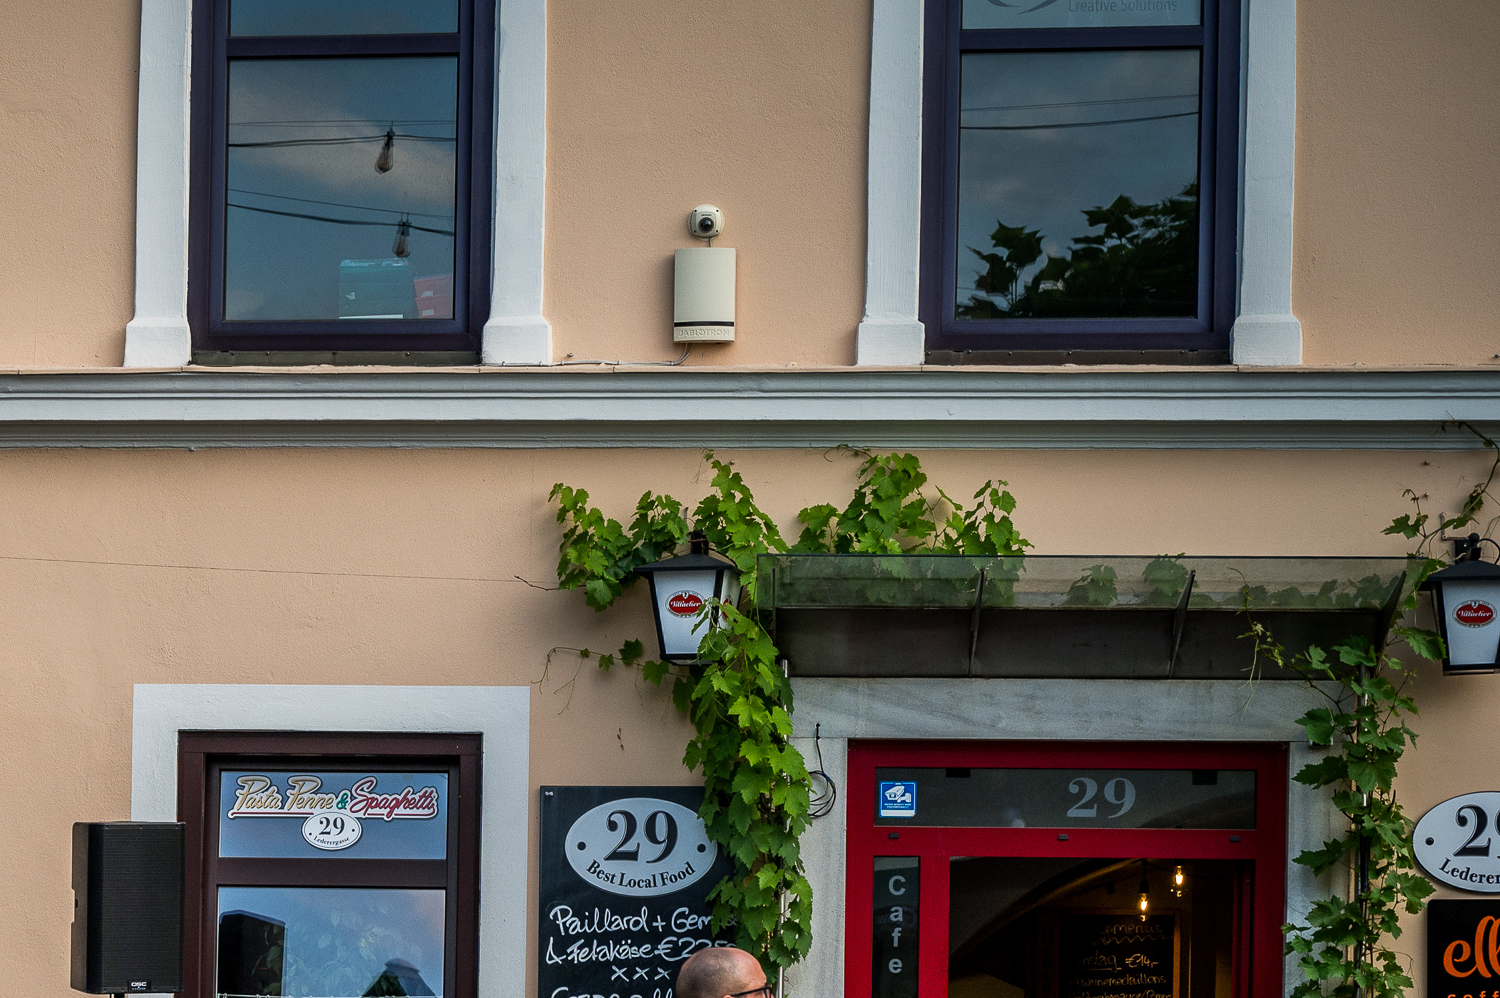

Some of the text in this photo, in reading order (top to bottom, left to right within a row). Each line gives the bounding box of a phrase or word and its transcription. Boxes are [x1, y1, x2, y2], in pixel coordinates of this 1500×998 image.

[236, 778, 436, 819] Pasta Penne & Spaghetti
[1066, 777, 1136, 819] 29
[318, 816, 345, 836] 29
[604, 809, 678, 864] 29
[1453, 804, 1500, 858] 2
[586, 859, 696, 889] Best Local Food
[888, 875, 907, 974] Cafe
